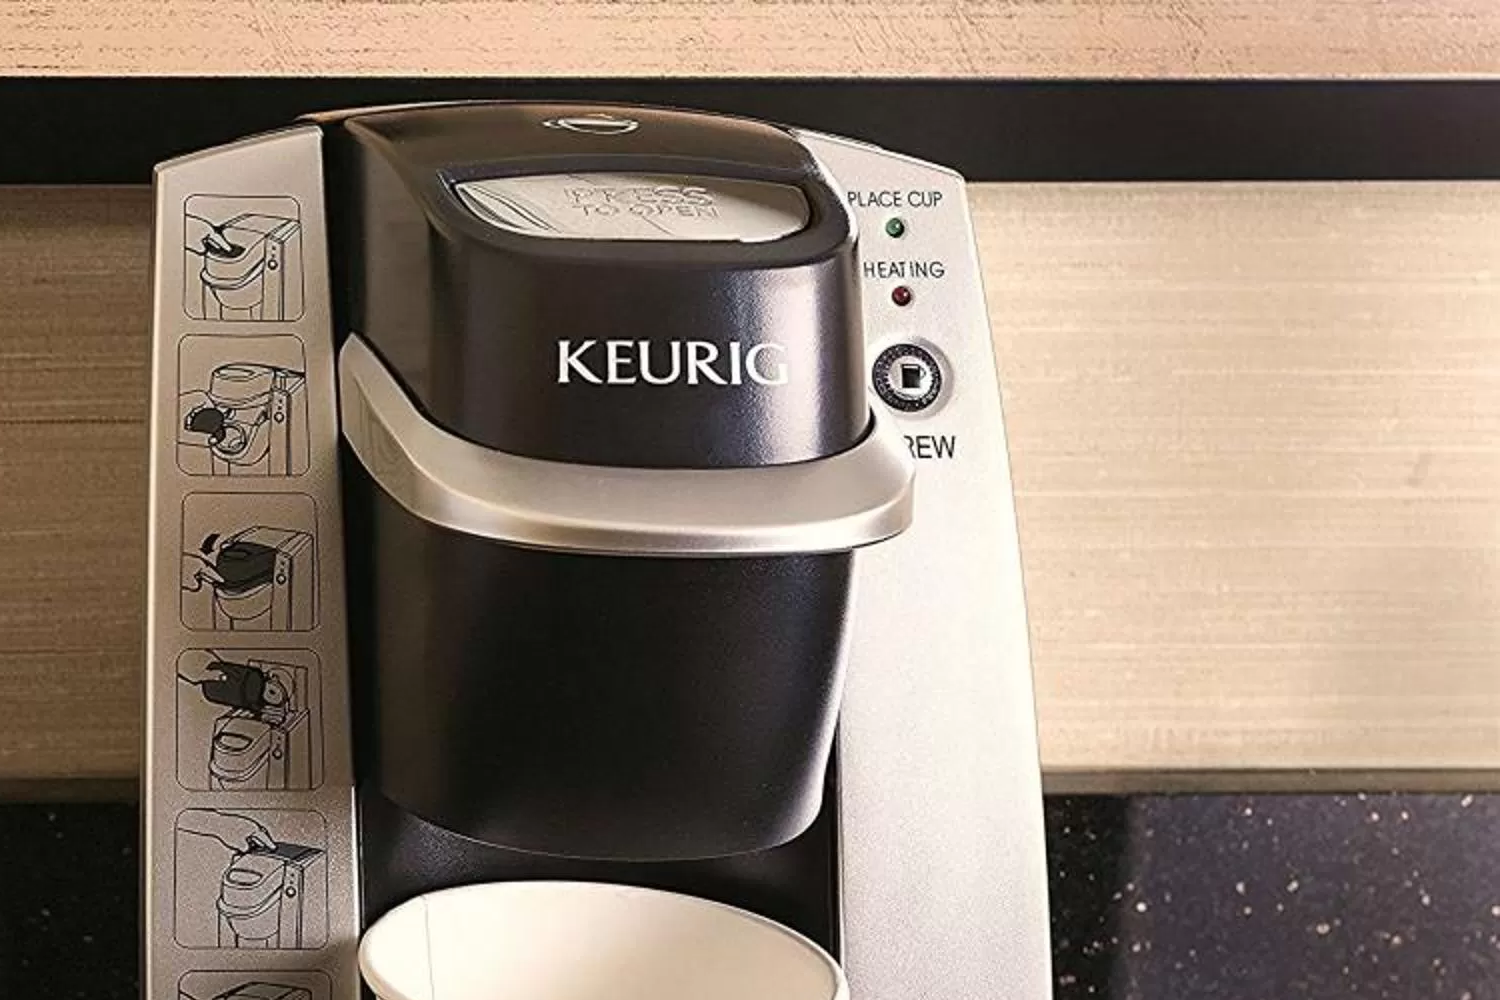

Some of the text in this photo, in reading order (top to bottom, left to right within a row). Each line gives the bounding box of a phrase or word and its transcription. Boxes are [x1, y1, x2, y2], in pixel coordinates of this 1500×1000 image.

[563, 185, 713, 206] PRESS
[846, 190, 944, 208] PLACE CUP
[572, 203, 720, 217] TO OPEN
[862, 260, 946, 279] HEATING
[557, 338, 790, 386] KEURIG
[903, 434, 957, 460] REW
